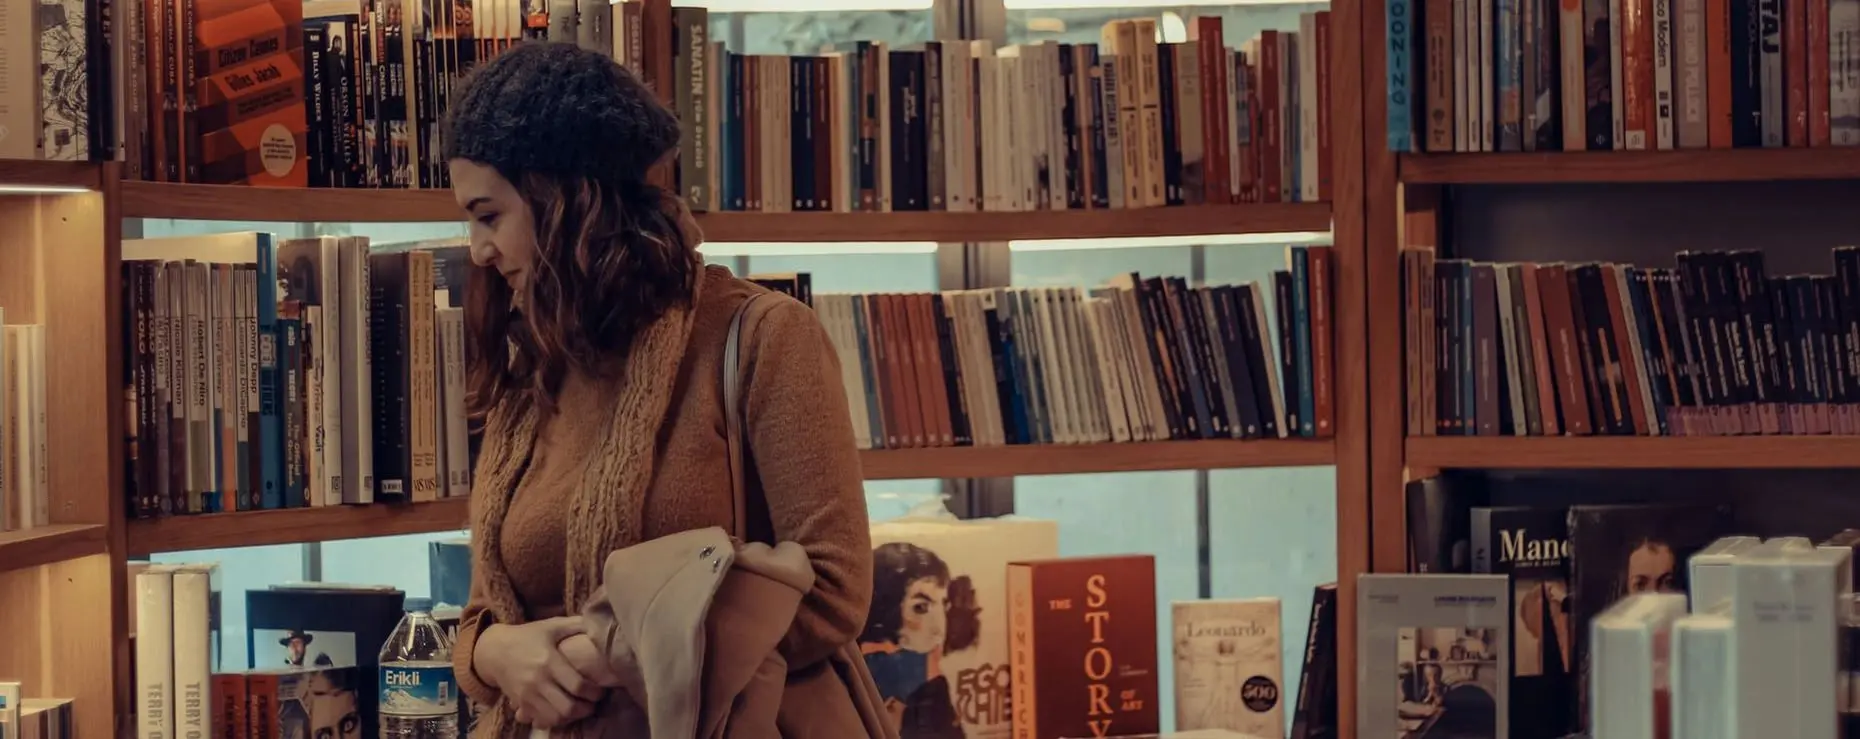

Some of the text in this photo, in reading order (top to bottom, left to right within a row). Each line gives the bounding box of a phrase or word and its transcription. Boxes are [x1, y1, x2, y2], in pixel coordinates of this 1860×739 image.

[376, 1, 384, 24] NEW
[311, 51, 321, 80] BILLY
[690, 24, 704, 96] SANATIN
[1657, 20, 1668, 68] Modern
[312, 82, 323, 122] WILDER
[379, 64, 387, 102] CINEMA
[340, 76, 352, 164] ORSON WELLES
[138, 308, 146, 354] SOLO
[174, 319, 183, 405] Nicole Kidman
[198, 320, 207, 406] Robert De Niro
[239, 319, 248, 428] Leonardo DiCaprio
[249, 319, 258, 394] Johnny Depp
[1048, 598, 1073, 611] THE
[1186, 620, 1267, 638] Leonardo
[384, 669, 421, 686] Erikli
[1242, 684, 1277, 701] 500
[147, 682, 163, 728] TERRY
[185, 682, 201, 727] TERRY
